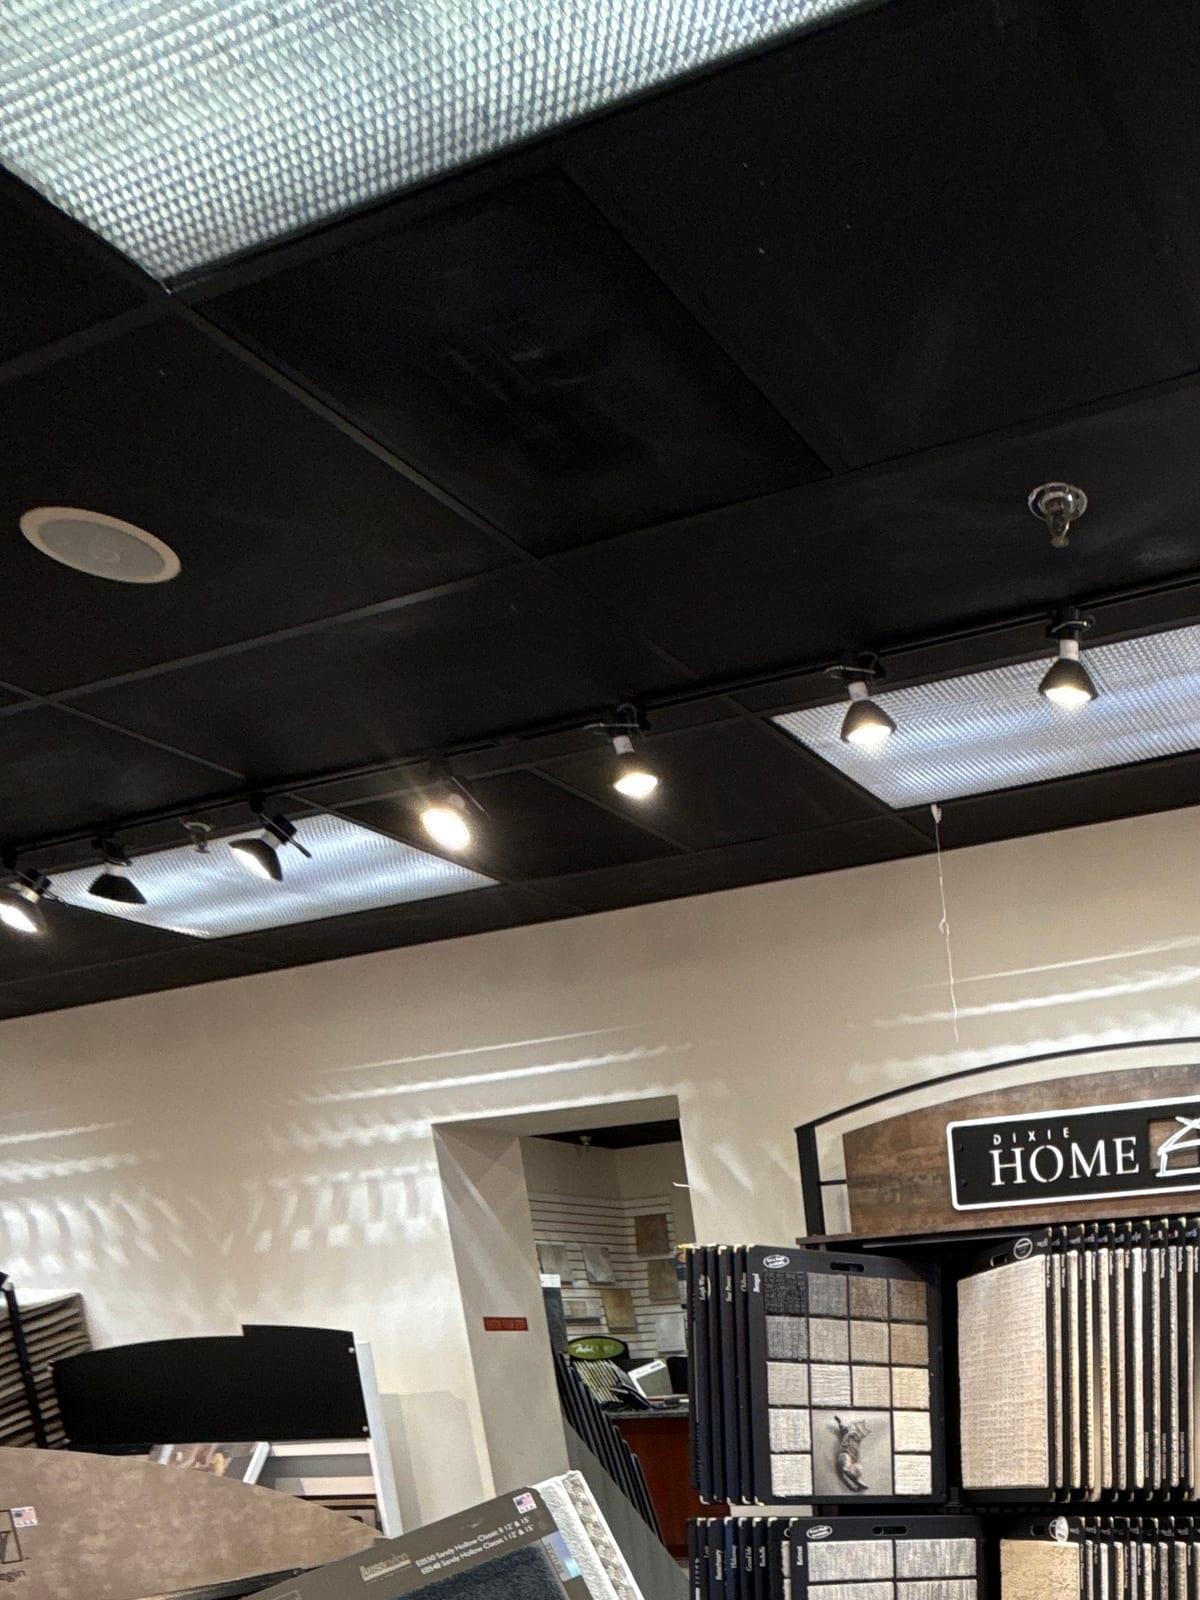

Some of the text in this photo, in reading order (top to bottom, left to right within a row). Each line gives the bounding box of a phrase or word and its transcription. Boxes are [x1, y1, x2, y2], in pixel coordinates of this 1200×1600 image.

[993, 1127, 1071, 1146] DIXIE
[990, 1136, 1140, 1187] HOME
[455, 1537, 478, 1551] Hollow
[477, 1529, 498, 1542] Classic
[460, 1545, 482, 1558] Hollow
[482, 1536, 504, 1550] Classic
